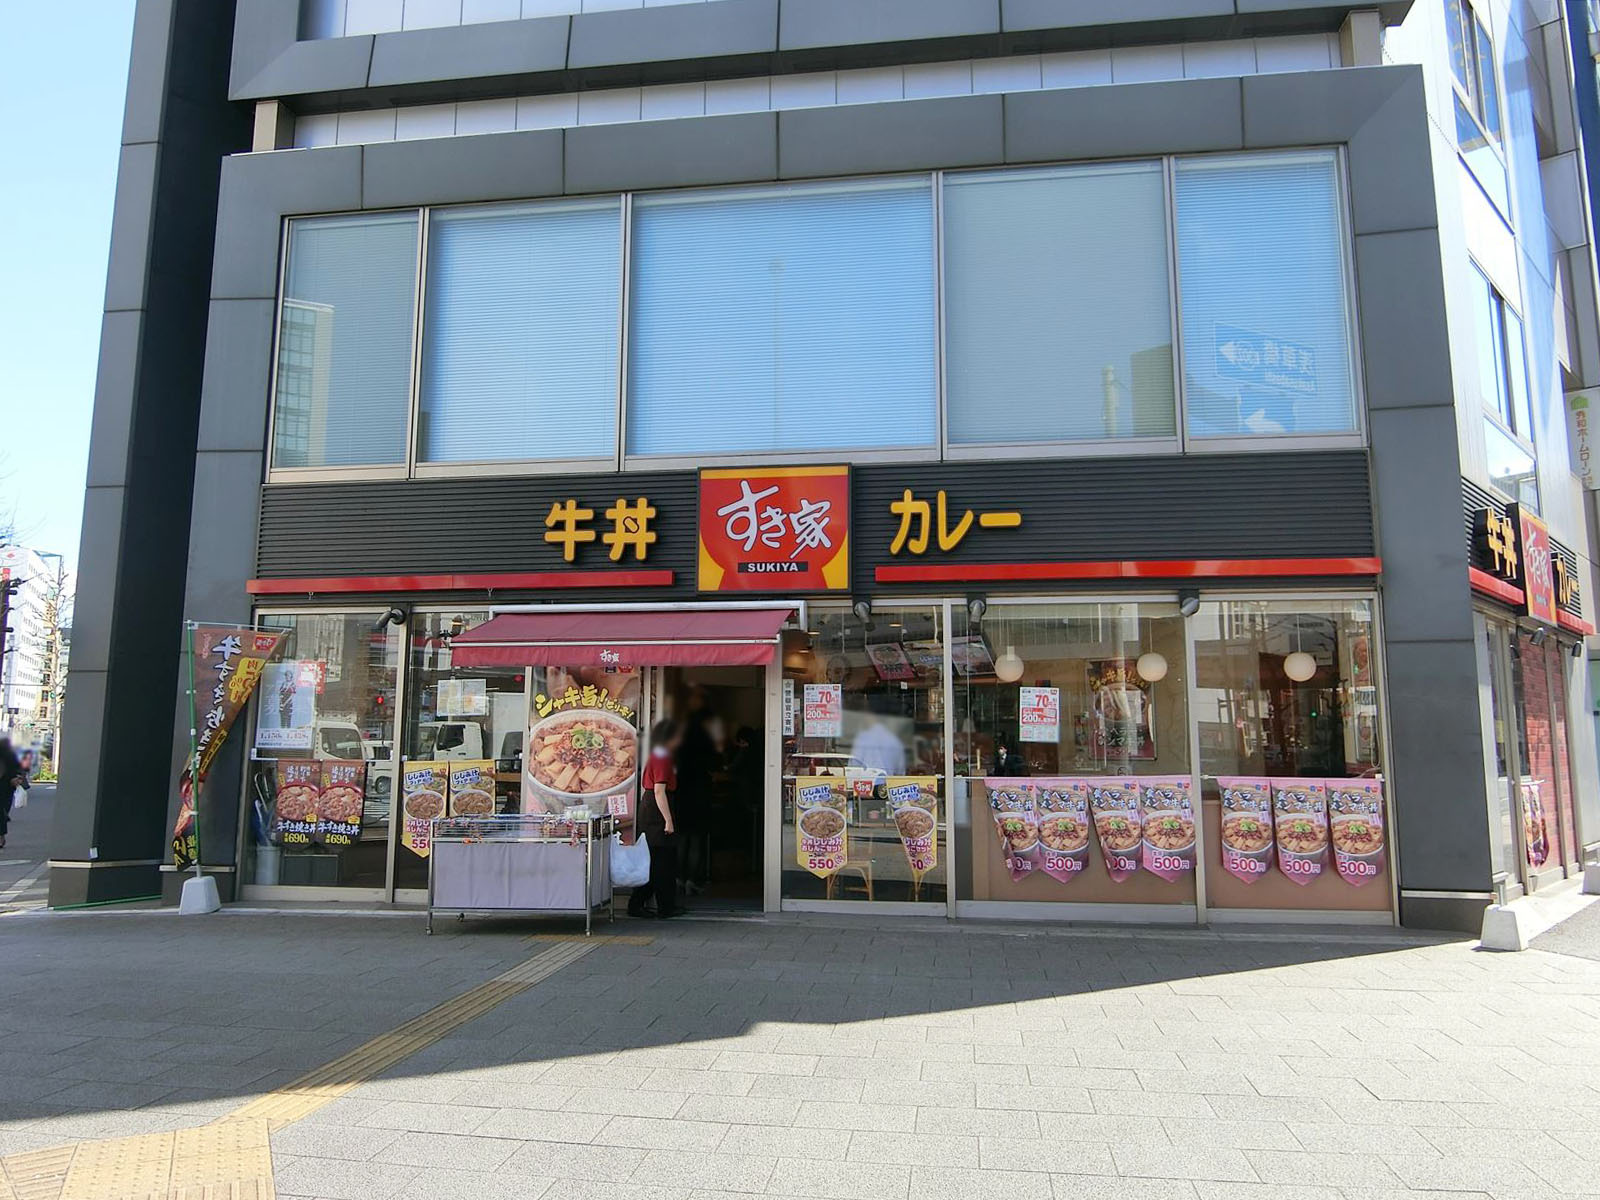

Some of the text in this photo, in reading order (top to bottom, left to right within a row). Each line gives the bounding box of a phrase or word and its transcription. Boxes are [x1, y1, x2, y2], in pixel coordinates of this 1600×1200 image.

[716, 479, 832, 560] すき家
[890, 488, 1022, 555] カレー
[543, 496, 657, 562] 牛丼
[1487, 506, 1518, 580] 牛丼
[747, 562, 799, 572] SUKIYA
[600, 649, 620, 664] すき家
[411, 838, 430, 850] 55
[1046, 857, 1082, 870] 500円
[1153, 856, 1190, 870] 500円
[1230, 857, 1266, 872] 500円
[1284, 859, 1321, 874] 500円
[1340, 860, 1377, 875] 500円
